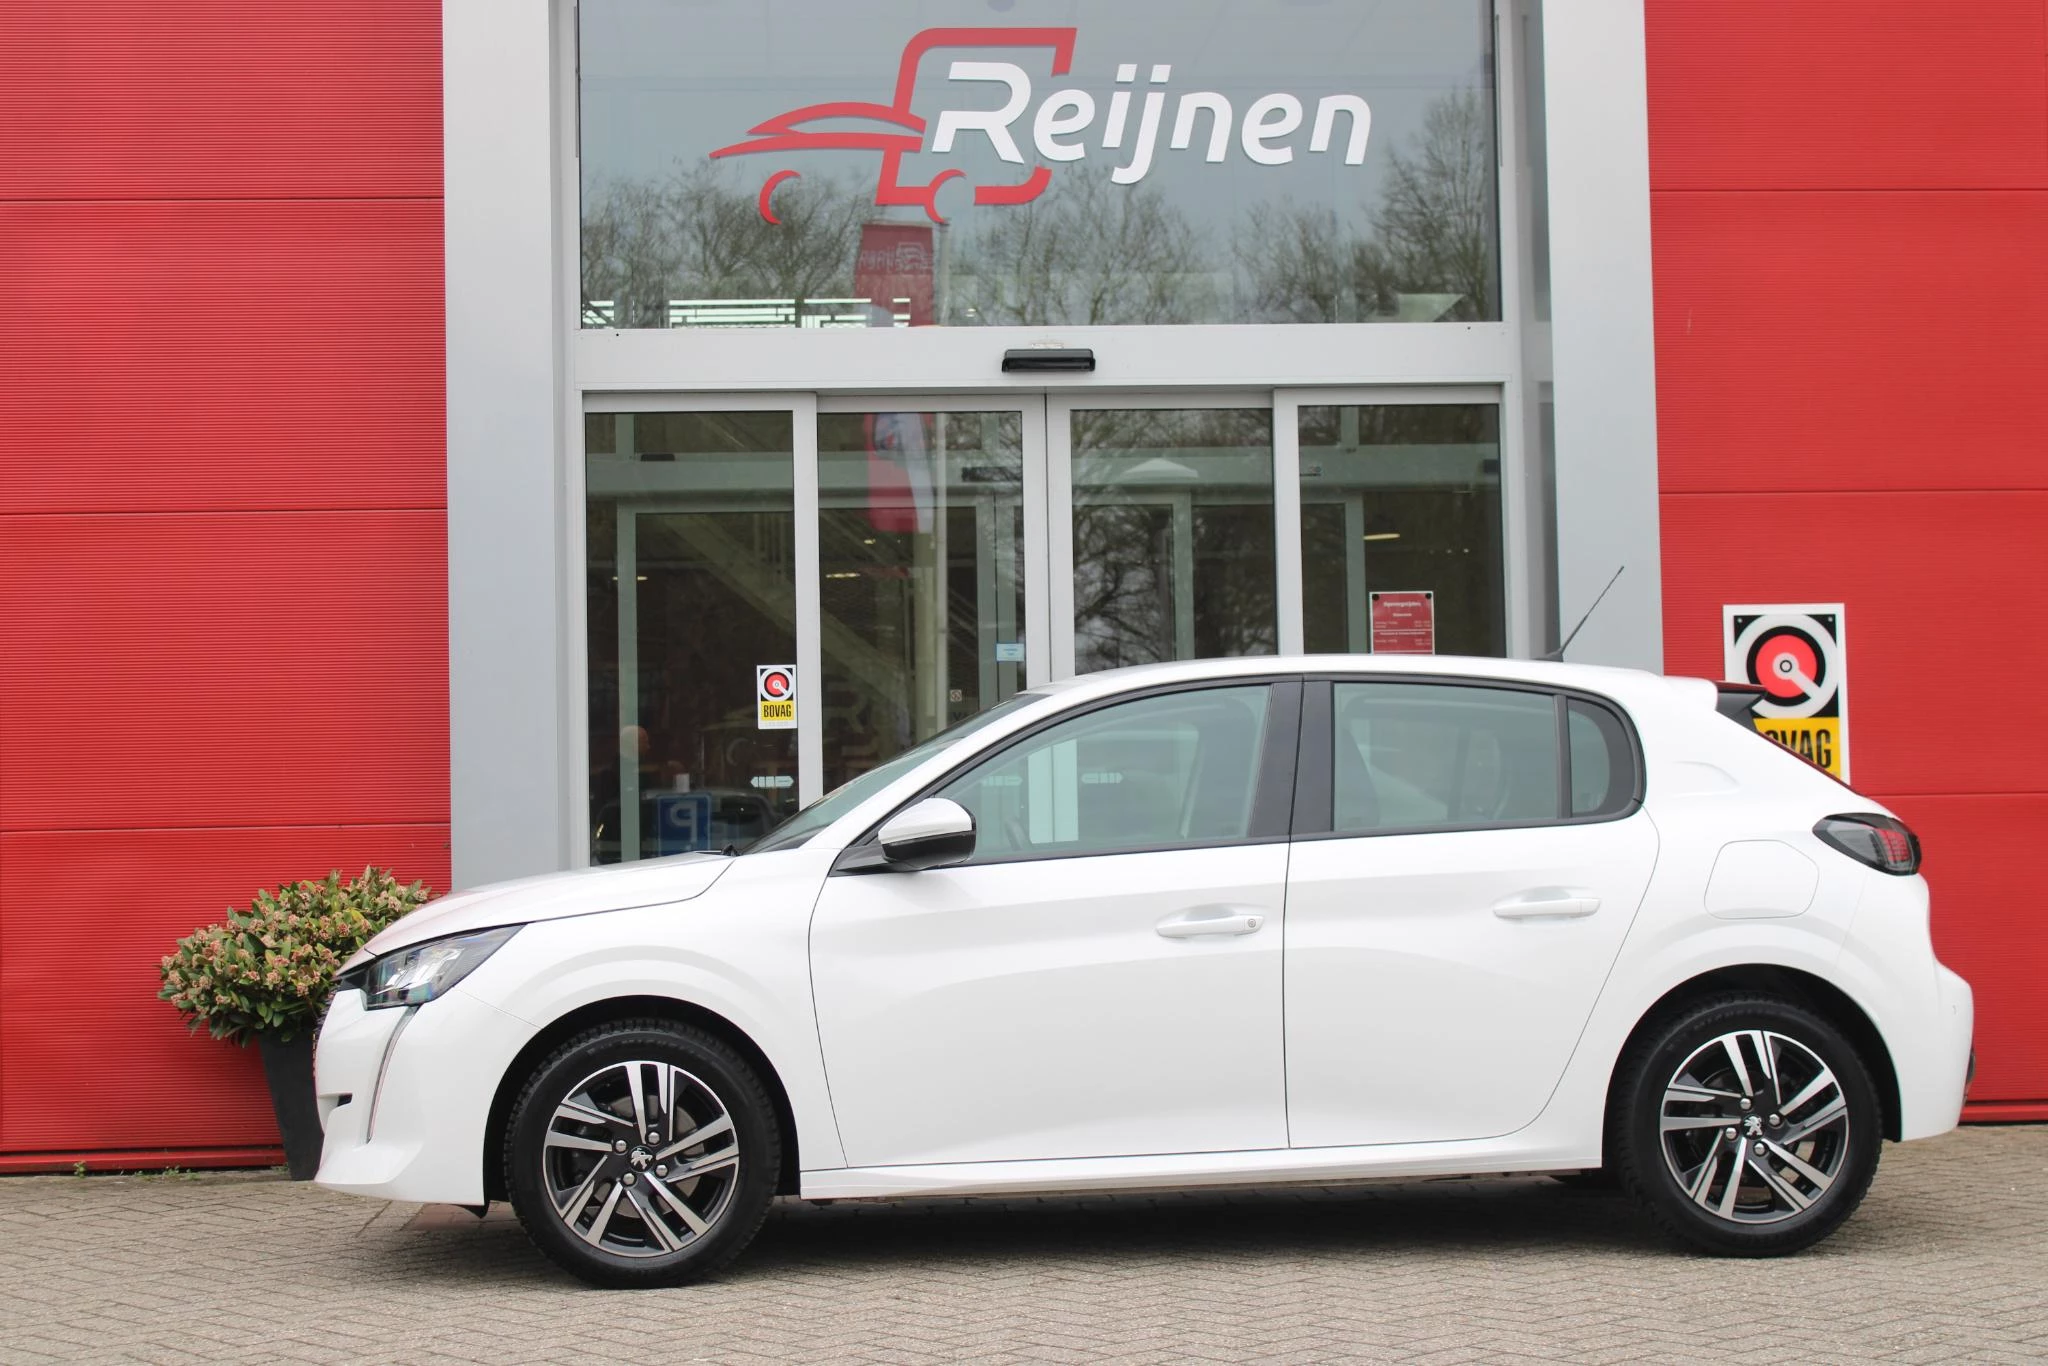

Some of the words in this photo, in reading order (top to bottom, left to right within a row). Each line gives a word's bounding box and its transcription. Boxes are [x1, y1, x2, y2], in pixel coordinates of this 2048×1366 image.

[931, 61, 1372, 186] Reijnen
[763, 704, 792, 718] BOVAG
[1764, 728, 1832, 769] VAG
